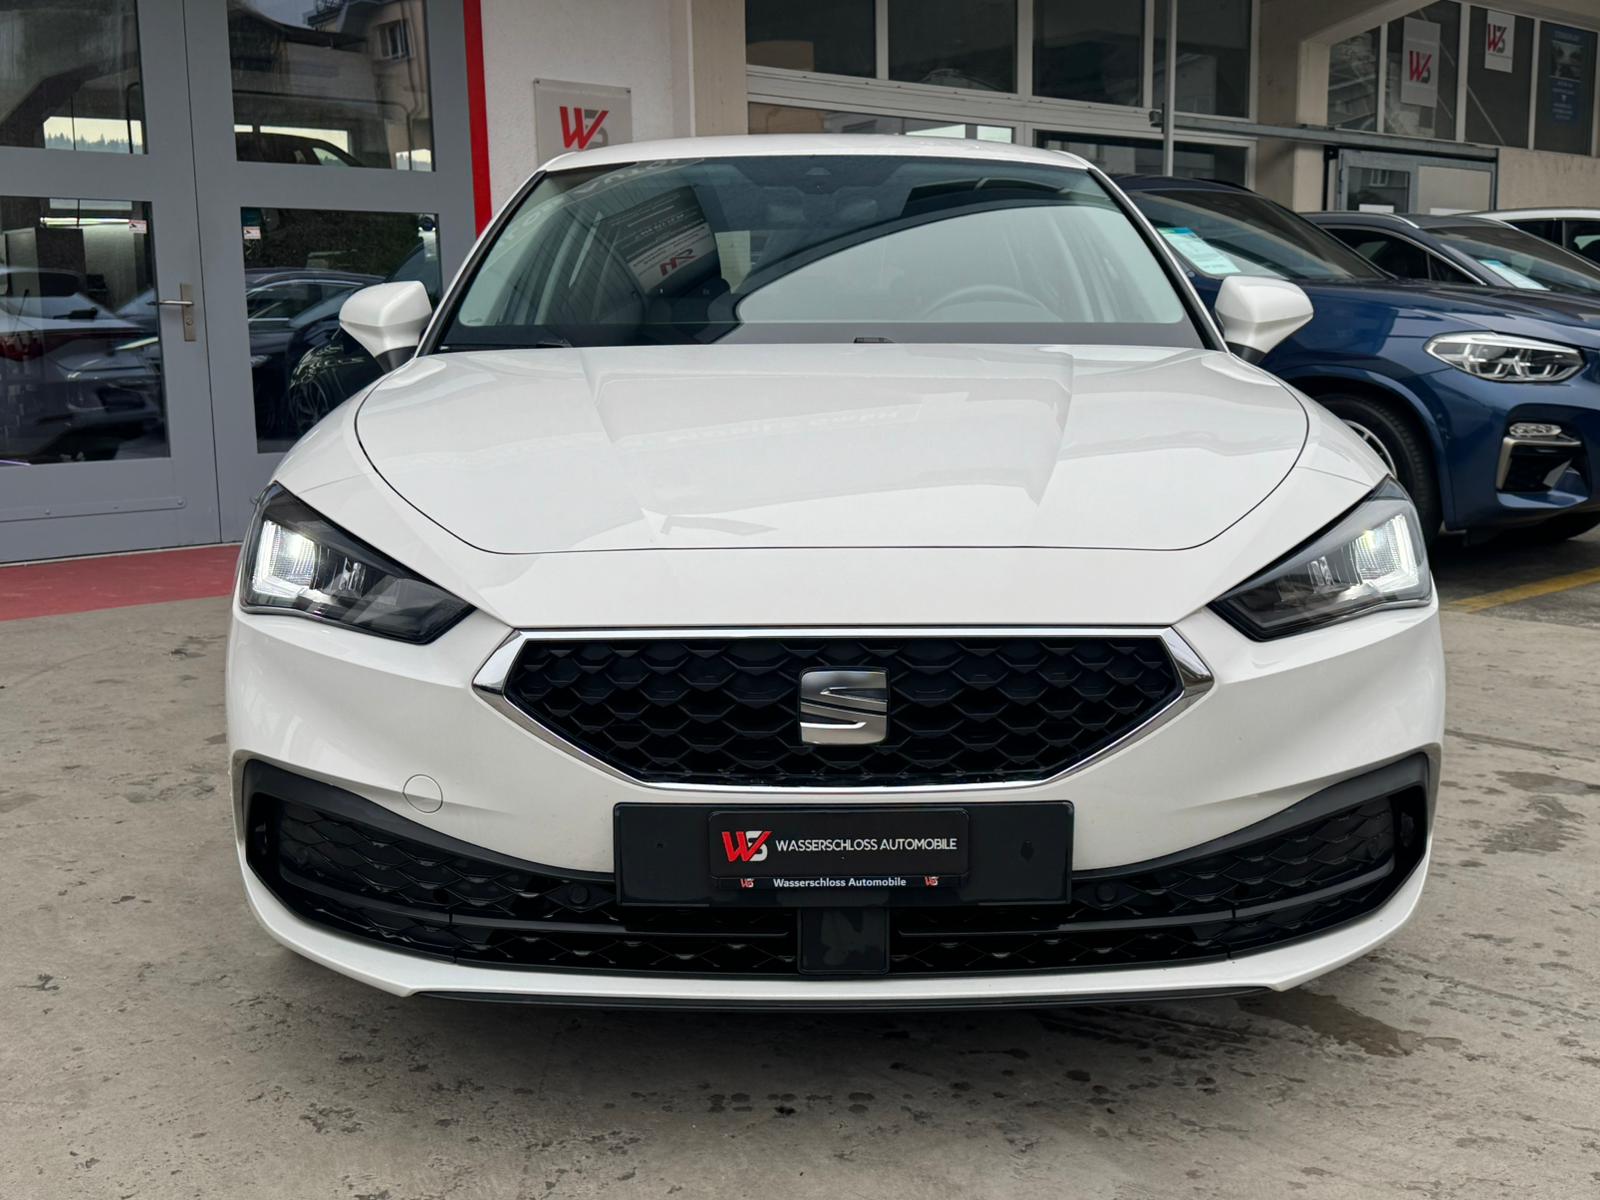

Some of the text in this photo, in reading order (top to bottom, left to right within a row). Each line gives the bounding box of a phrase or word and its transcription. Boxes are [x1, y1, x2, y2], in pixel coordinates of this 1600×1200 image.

[775, 839, 878, 852] WASSERSCHLOSS
[879, 838, 958, 851] AUTOMOBILE
[773, 876, 846, 888] Wasserschloss
[848, 875, 907, 887] Automobile
